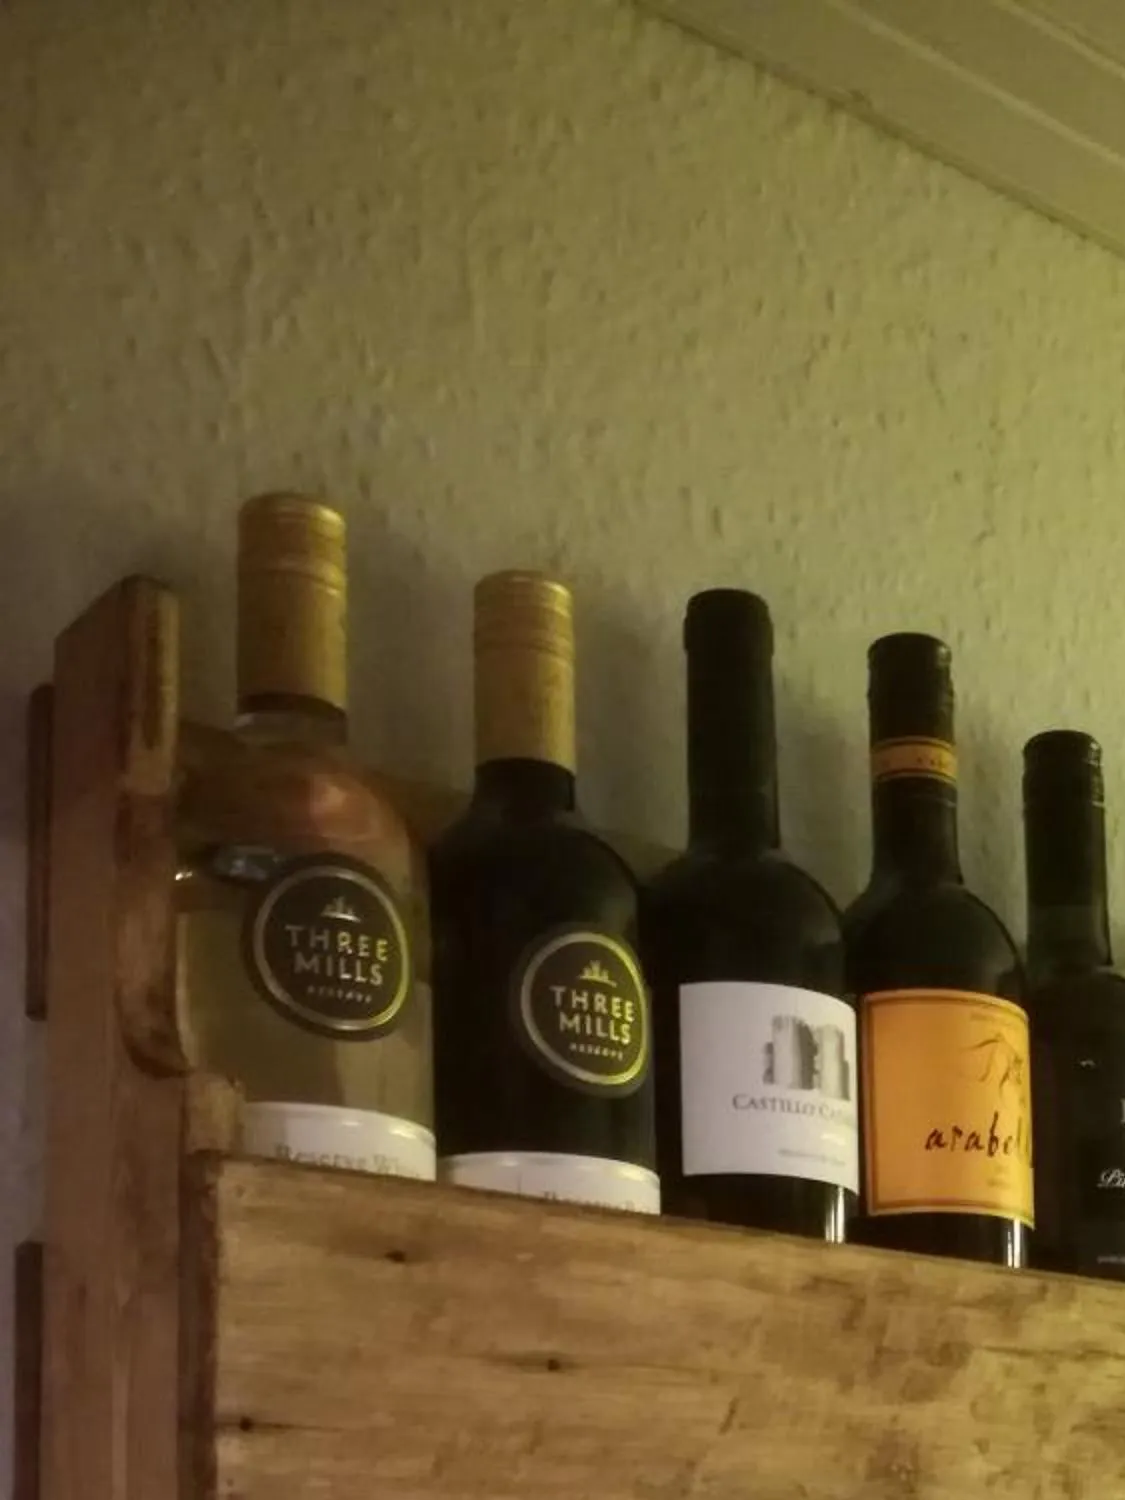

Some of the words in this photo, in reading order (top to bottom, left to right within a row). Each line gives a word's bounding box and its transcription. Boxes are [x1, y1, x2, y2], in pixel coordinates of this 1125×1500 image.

[285, 924, 389, 962] THREE
[294, 951, 384, 987] MILLS
[549, 985, 635, 1023] THREE
[560, 1011, 631, 1045] MILLS
